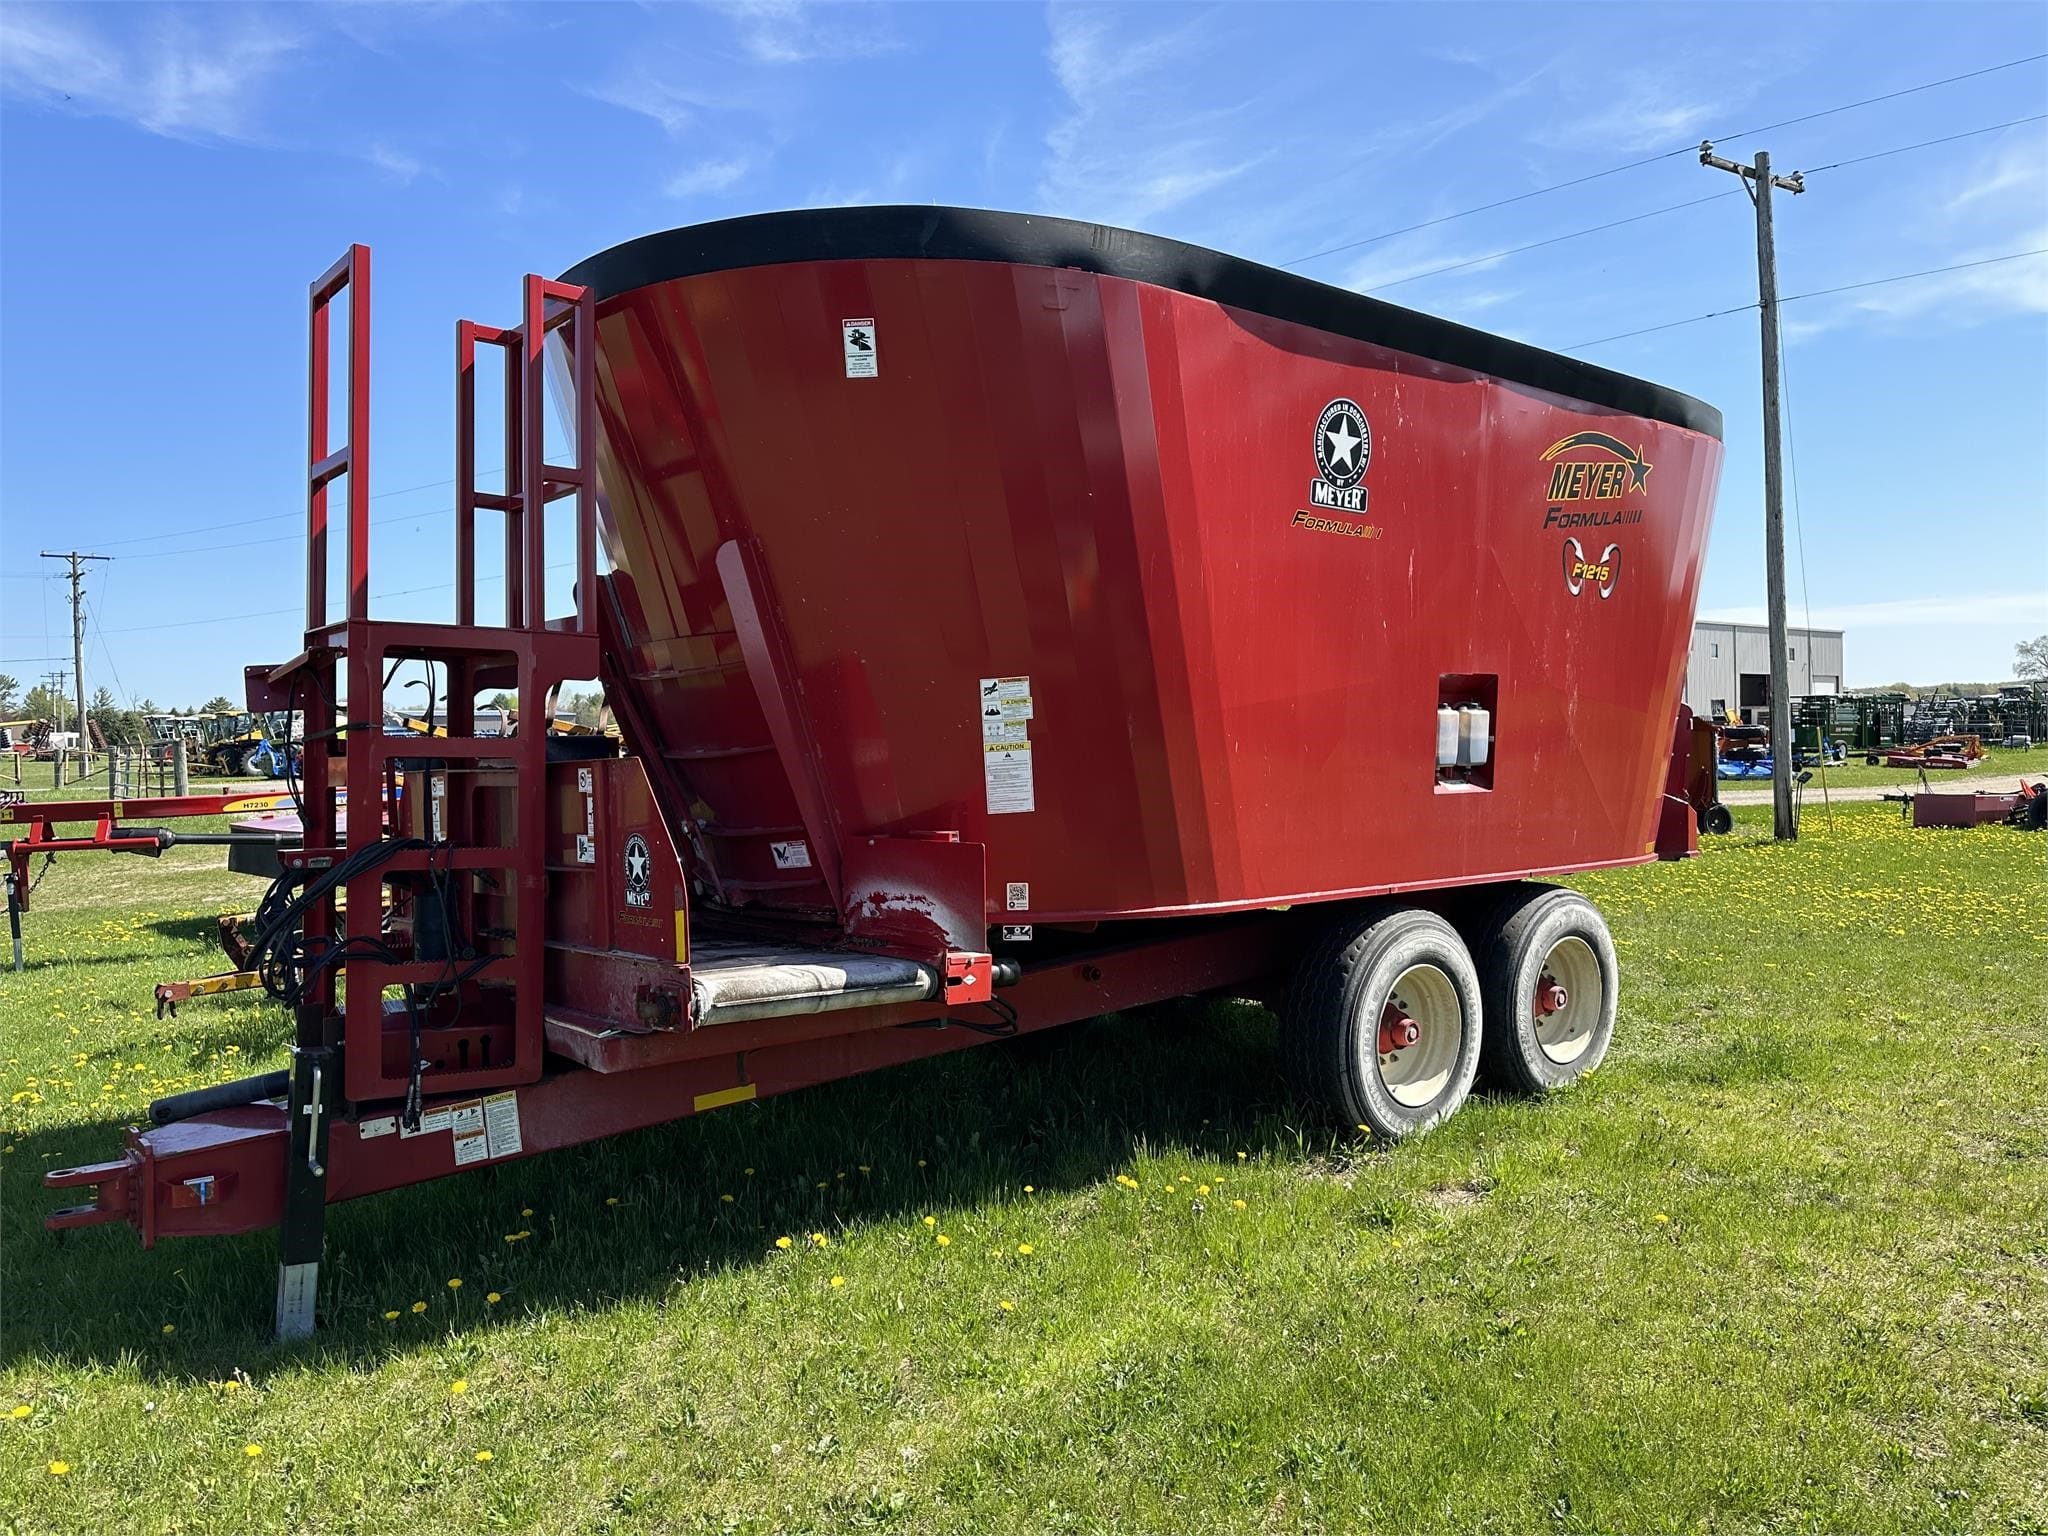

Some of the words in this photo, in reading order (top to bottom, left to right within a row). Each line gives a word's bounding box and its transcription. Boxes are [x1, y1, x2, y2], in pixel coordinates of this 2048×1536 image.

[1316, 403, 1342, 459] MANUFACTURED
[1342, 403, 1349, 411] IN
[1349, 406, 1369, 455] DORCHESTER
[1336, 479, 1345, 487] BY
[1547, 462, 1627, 501] MEYER
[1314, 481, 1361, 510] MEYER
[1572, 563, 1611, 582] F1215
[995, 743, 1025, 751] CAUTION
[243, 801, 269, 809] H7230
